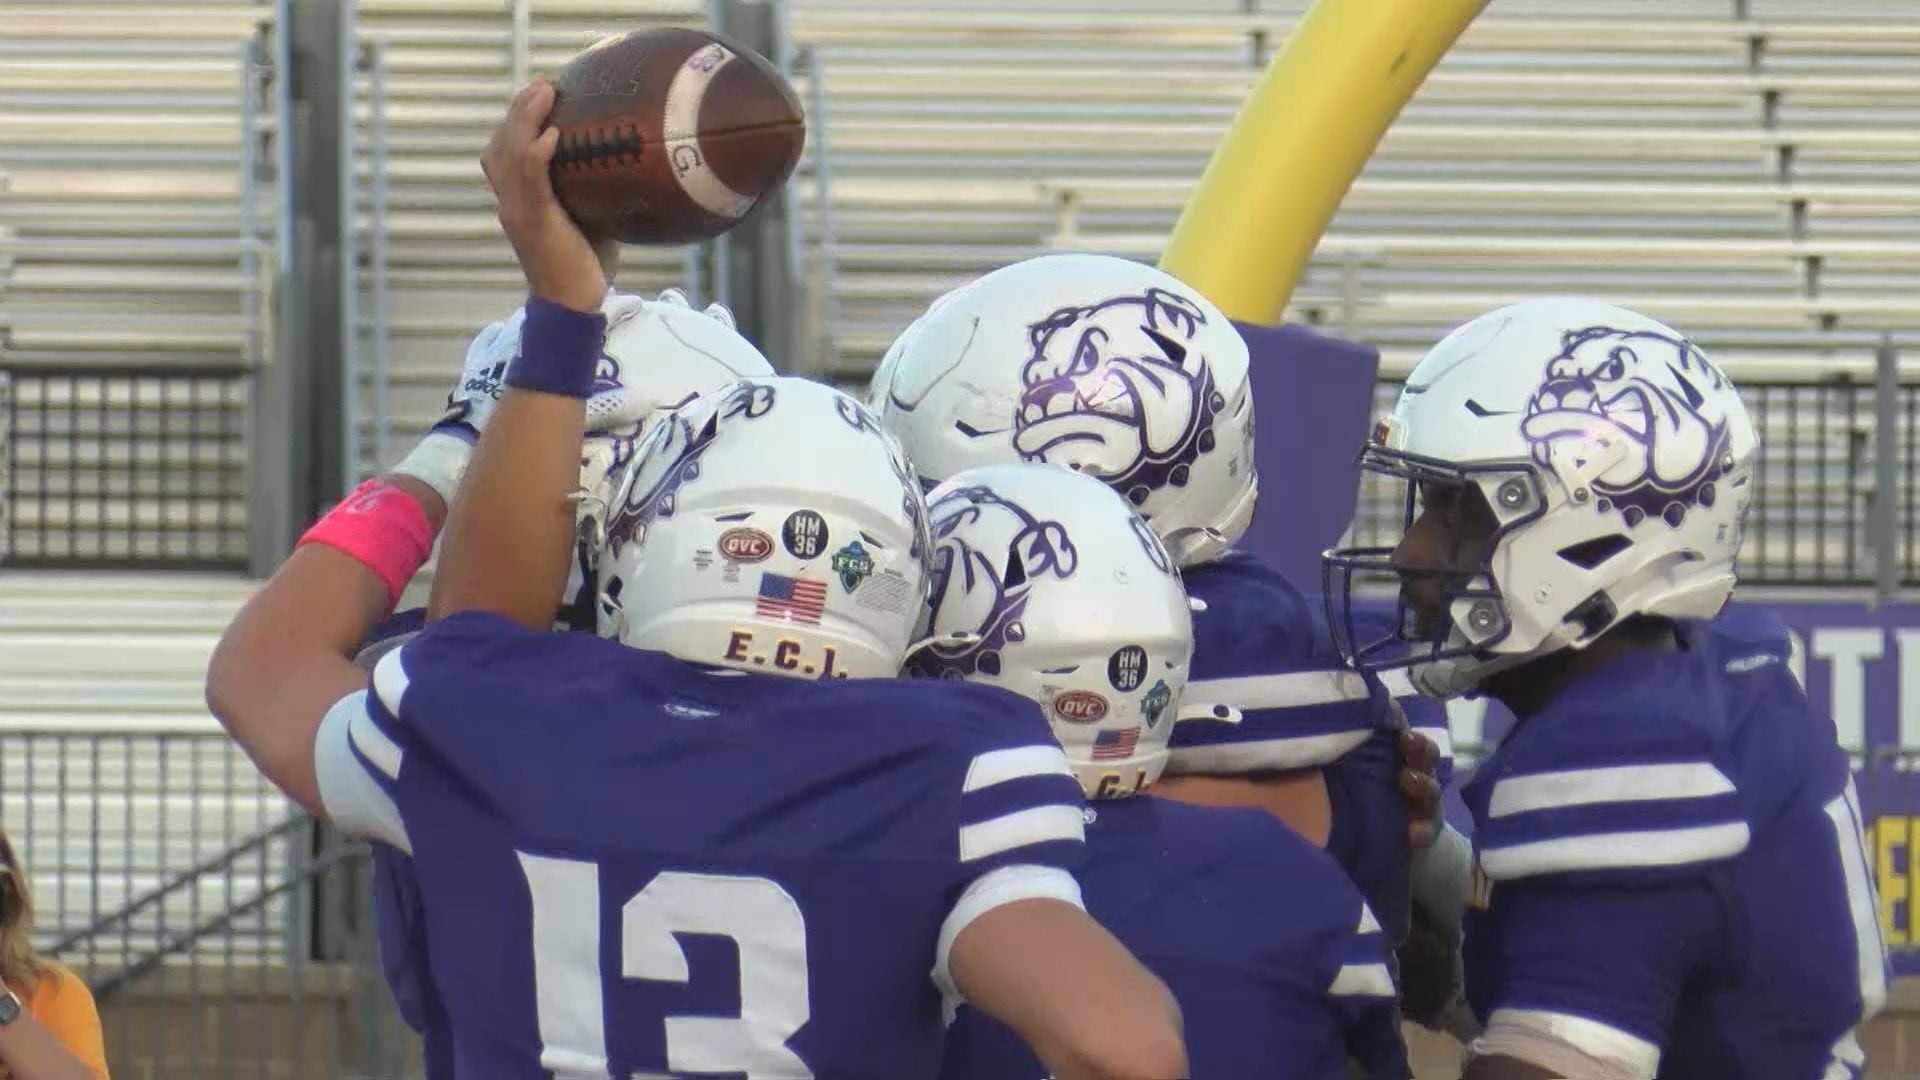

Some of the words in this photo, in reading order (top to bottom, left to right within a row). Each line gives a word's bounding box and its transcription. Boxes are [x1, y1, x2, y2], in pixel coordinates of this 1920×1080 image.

[794, 515, 821, 536] HM
[727, 538, 762, 554] OVC
[794, 535, 817, 555] 36
[1119, 651, 1141, 668] HM
[1118, 670, 1138, 688] 36
[1063, 701, 1098, 716] OVC
[512, 849, 817, 1080] 13
